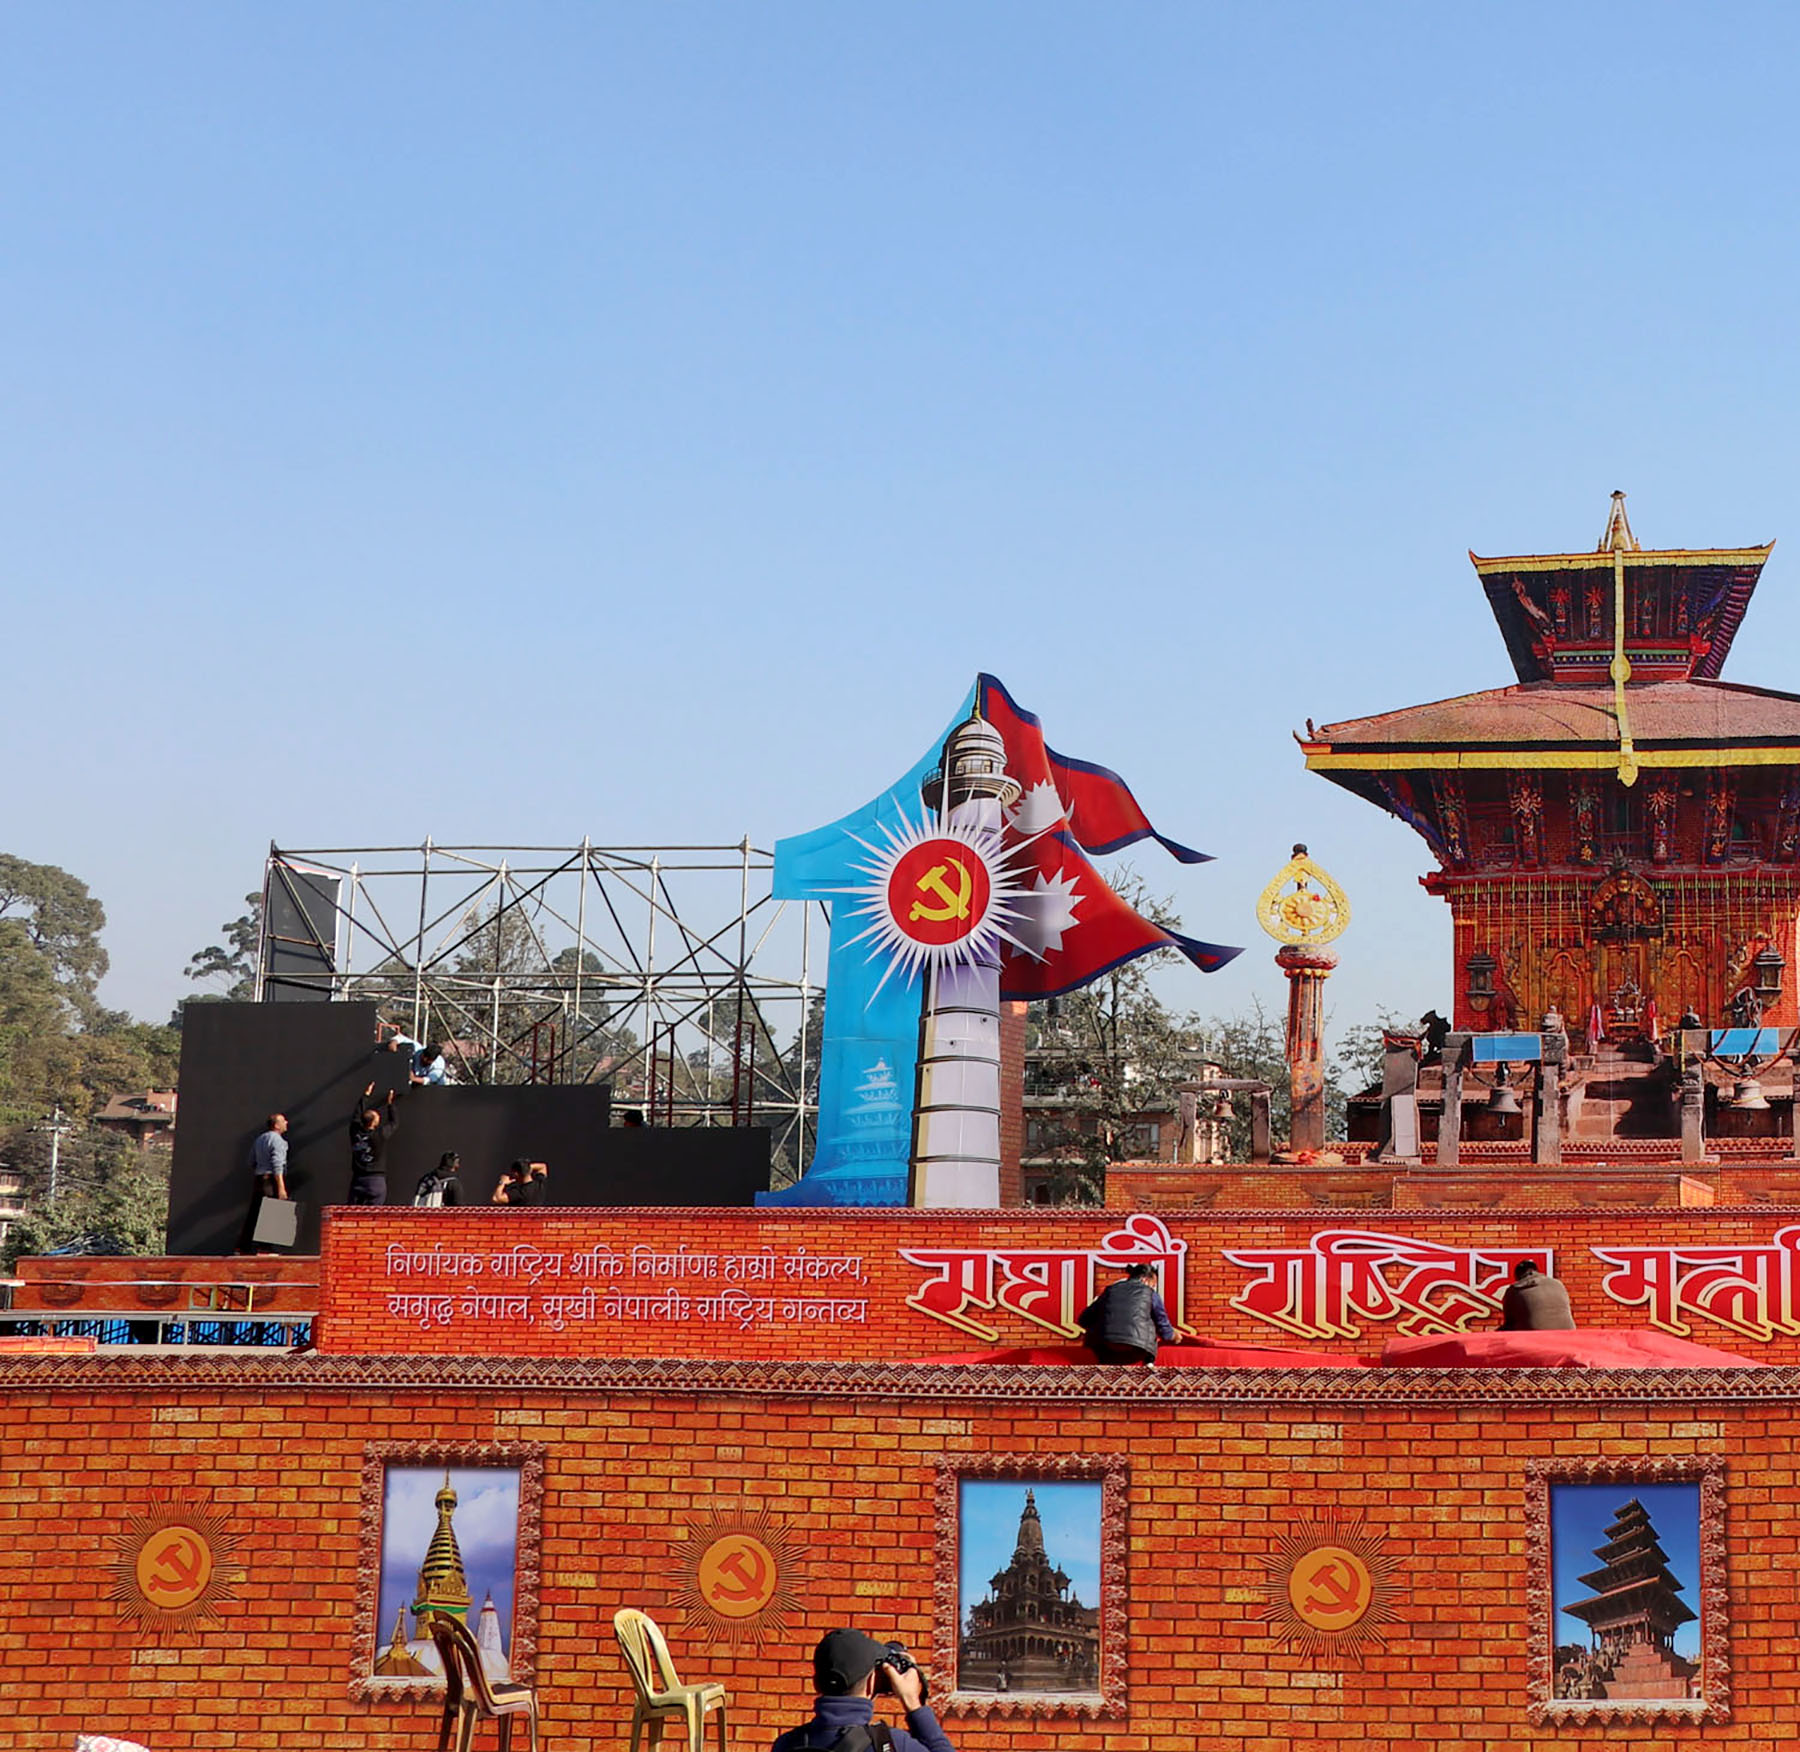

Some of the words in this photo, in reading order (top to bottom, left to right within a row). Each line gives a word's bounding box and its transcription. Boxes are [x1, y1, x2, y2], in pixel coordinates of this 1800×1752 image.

[385, 1242, 486, 1277] निर्णायक
[490, 1244, 565, 1286] राष्ट्रिय
[569, 1244, 626, 1278] शक्ति
[723, 1246, 779, 1283] हाम्रो
[783, 1247, 868, 1286] संकल्प,
[386, 1294, 456, 1331] समृद्ध
[460, 1286, 536, 1325] नेपाल,
[541, 1286, 599, 1331] सुखी
[695, 1288, 777, 1330] राष्ट्रिय
[781, 1298, 869, 1324] गन्तव्य
